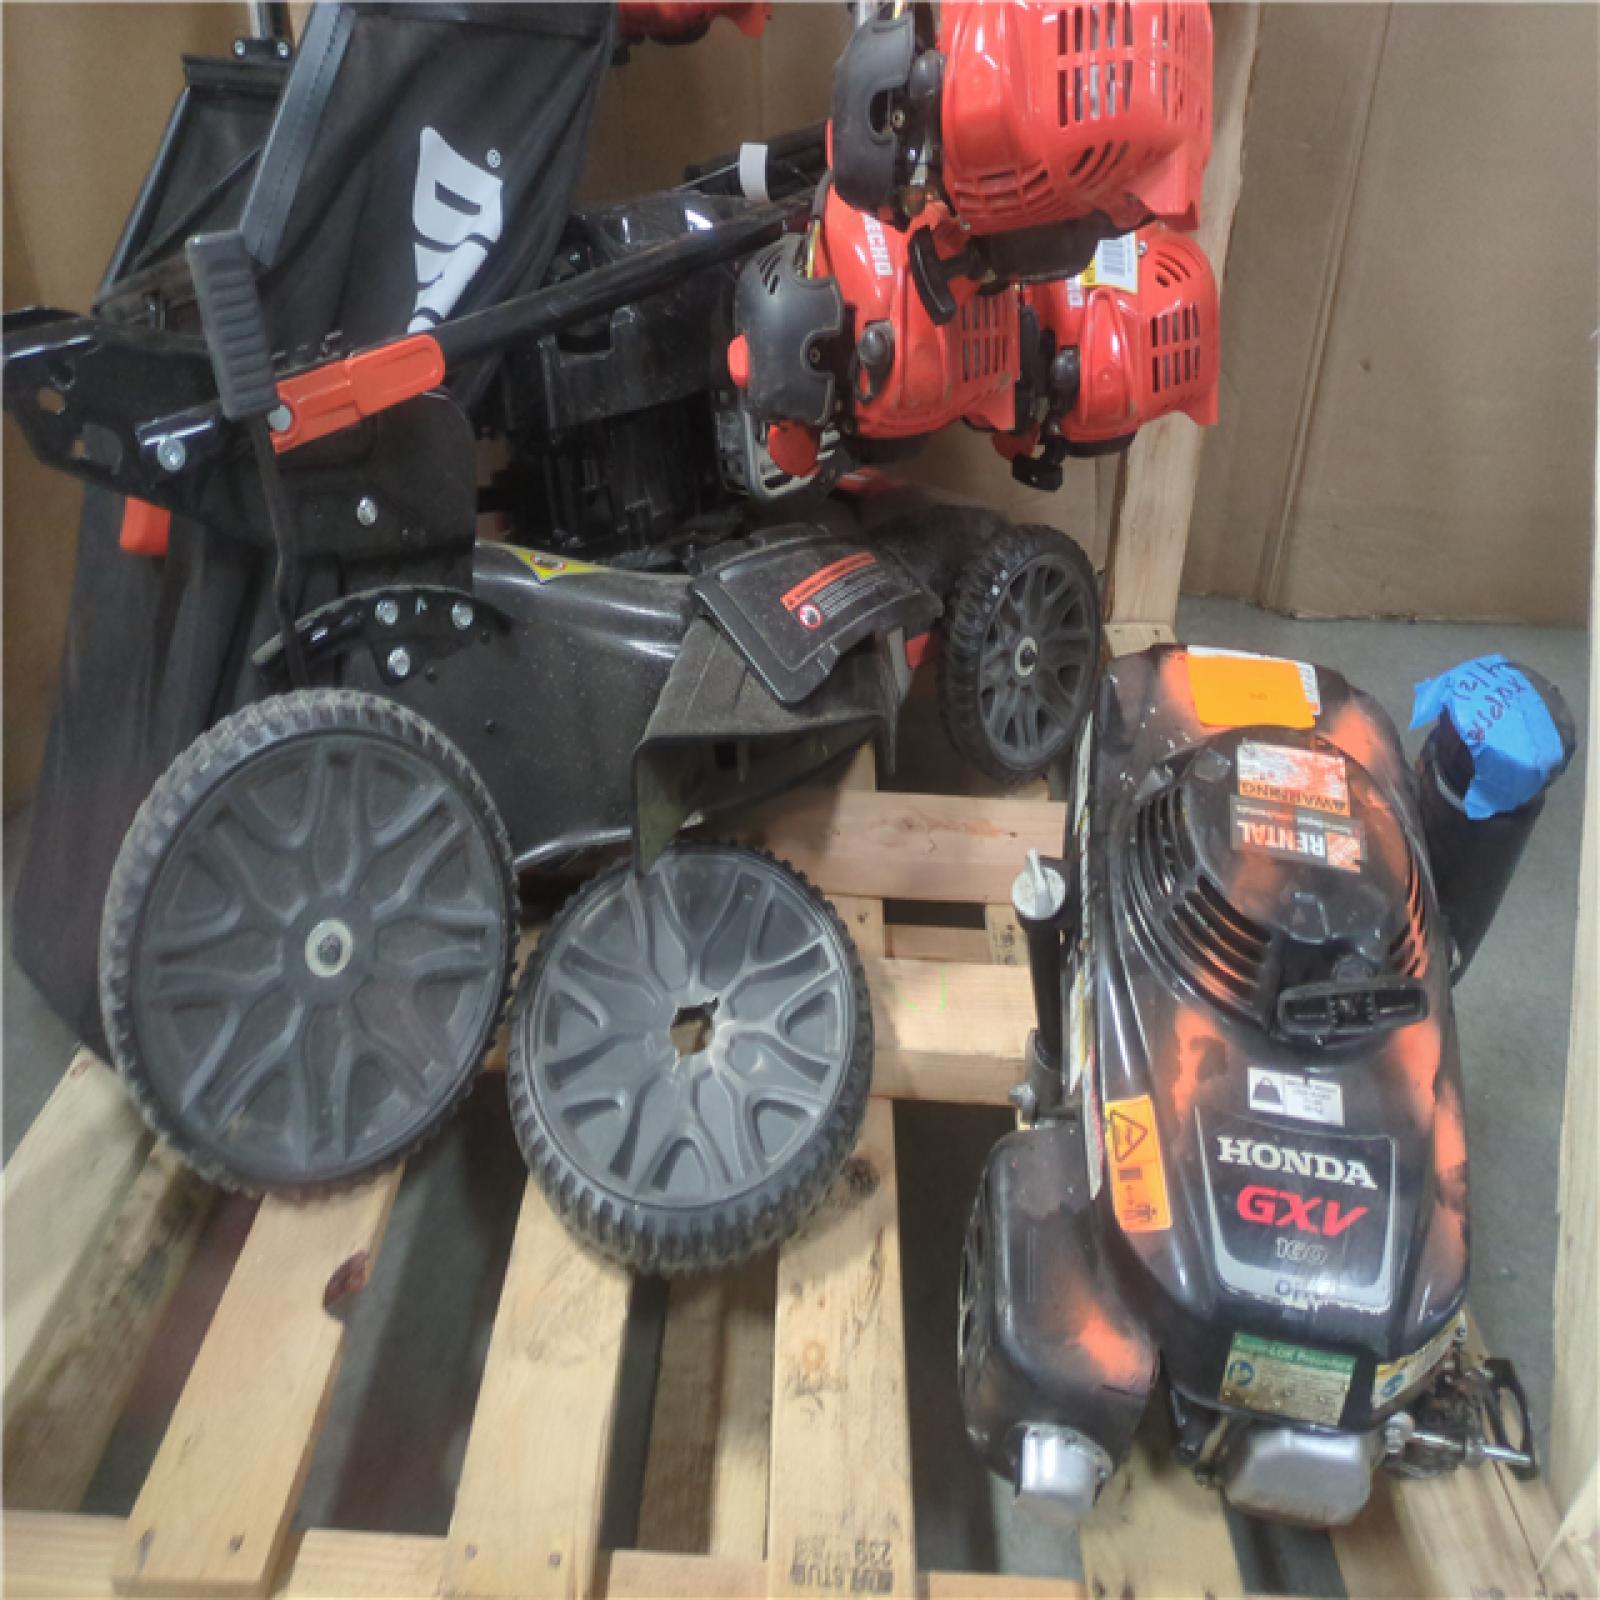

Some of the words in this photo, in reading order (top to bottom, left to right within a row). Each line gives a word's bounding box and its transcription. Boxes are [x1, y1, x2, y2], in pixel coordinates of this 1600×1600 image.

[1236, 820, 1326, 858] RENTAL
[1216, 1136, 1379, 1191] HONDA
[1236, 1183, 1369, 1238] GXV
